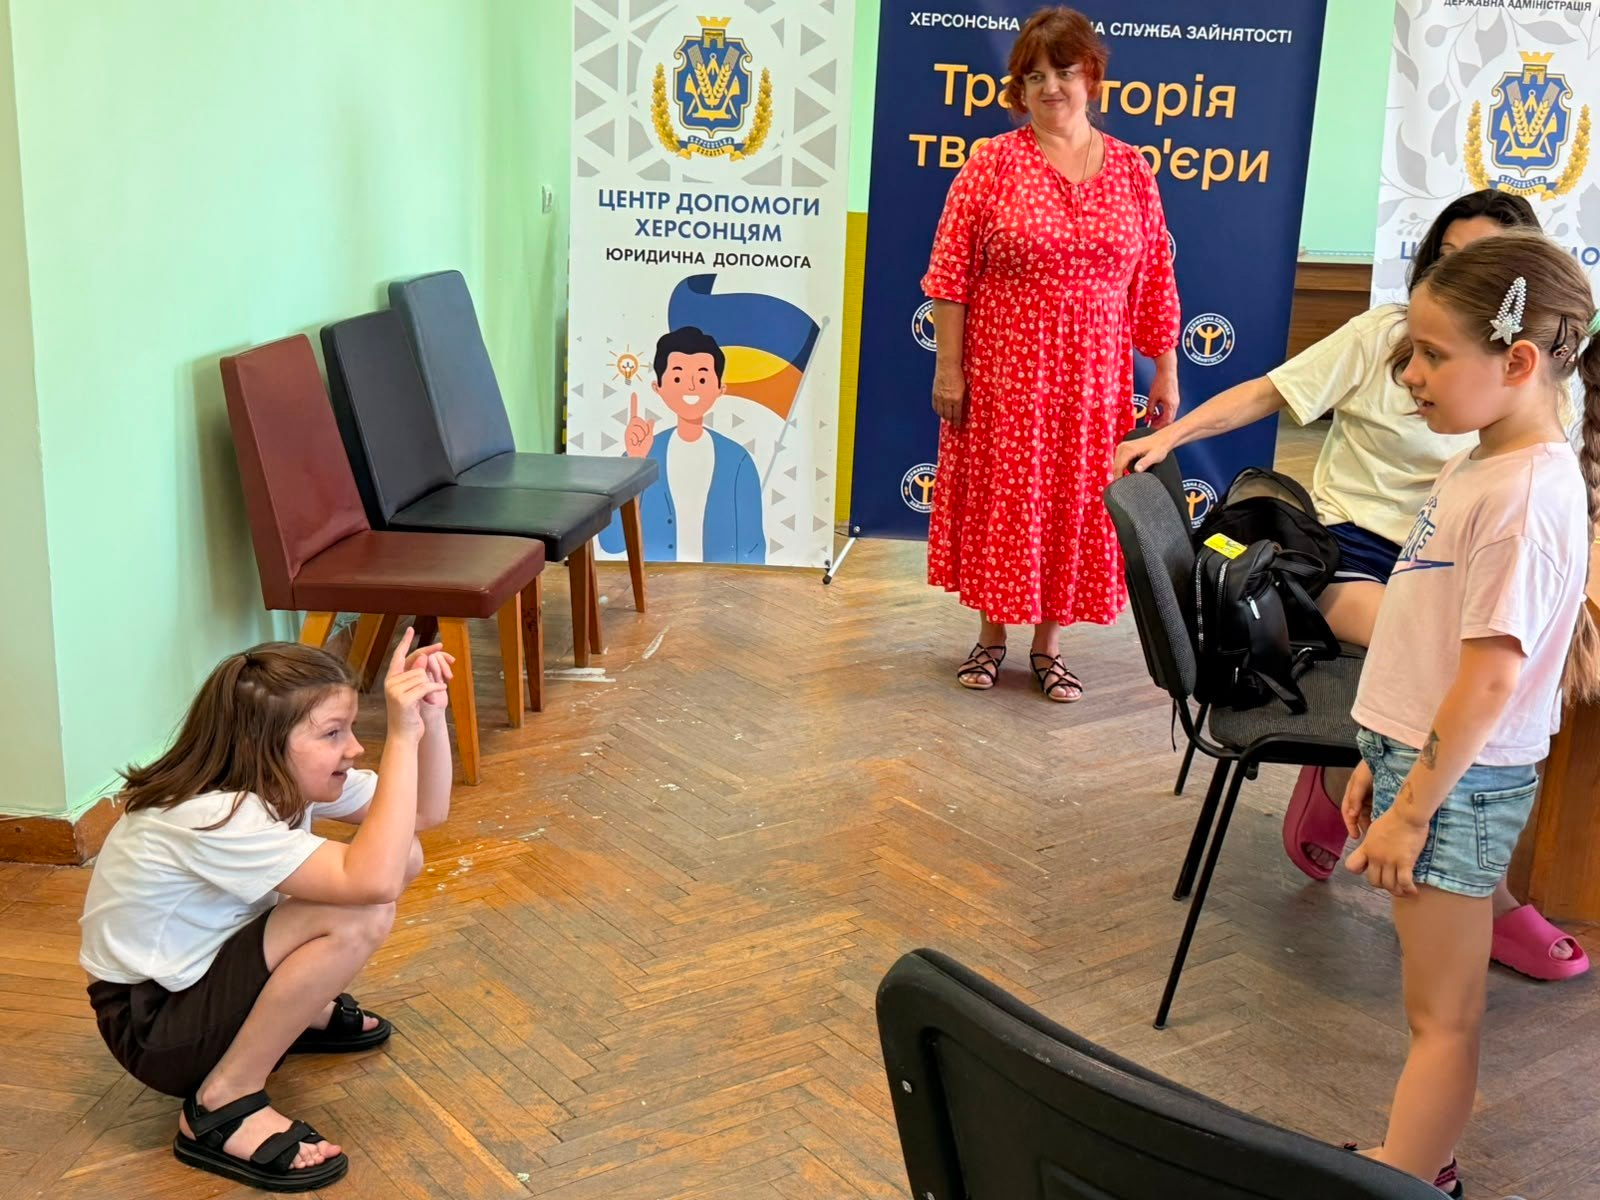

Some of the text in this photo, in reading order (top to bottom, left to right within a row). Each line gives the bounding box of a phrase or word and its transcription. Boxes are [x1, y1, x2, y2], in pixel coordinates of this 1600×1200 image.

[1507, 0, 1592, 12] АДМІНІСТРАЦІЯ
[909, 11, 1020, 32] ХЕРСОНСЬКА
[1110, 22, 1182, 39] СЛУЖБА
[1186, 24, 1292, 44] ЗАЙНЯТОСТІ
[933, 63, 1237, 126] Трторія
[598, 188, 820, 217] ЦЕНТР ДОПОМОГИ
[634, 218, 783, 245] ХЕРСОНЦЯМ
[606, 247, 812, 269] ЮРИДИЧНА ДОПОМОГА
